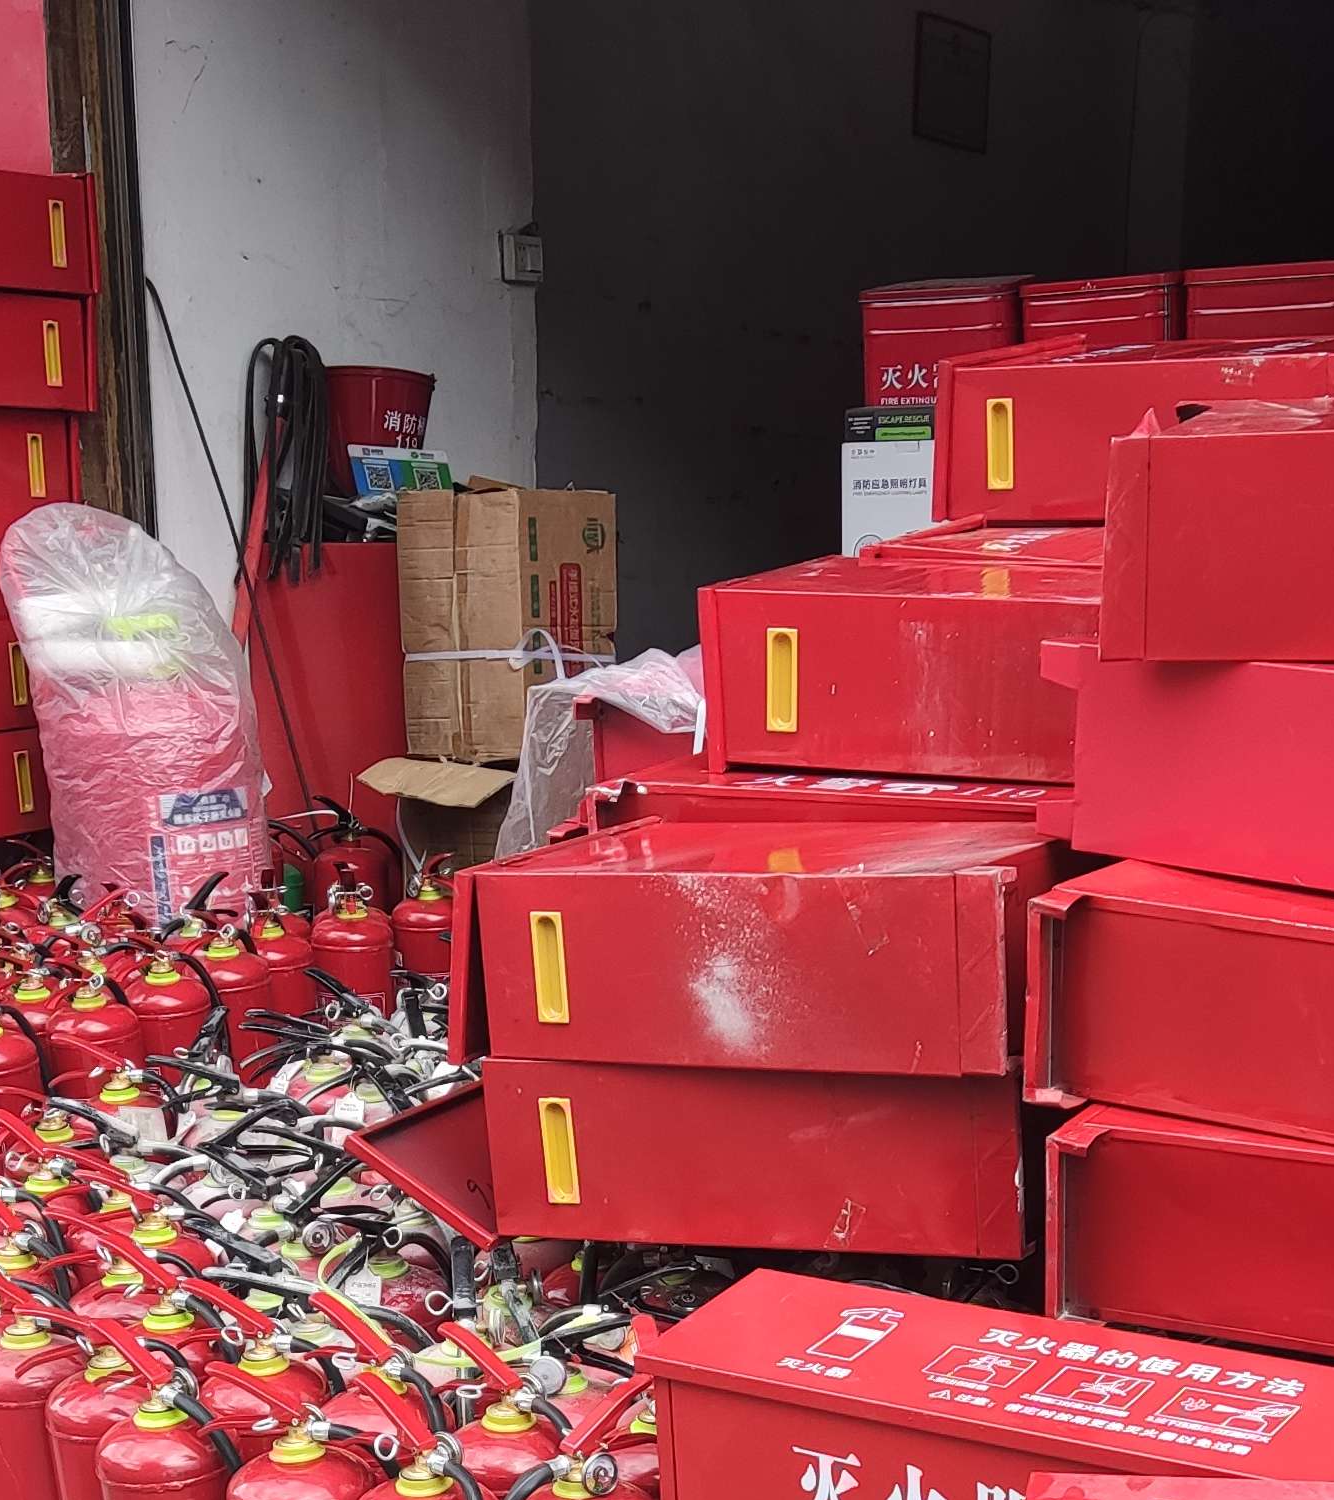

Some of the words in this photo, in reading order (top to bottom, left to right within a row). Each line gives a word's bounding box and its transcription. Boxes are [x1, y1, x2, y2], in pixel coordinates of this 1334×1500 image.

[880, 363, 939, 391] 灭火
[880, 396, 899, 406] FIRE
[852, 477, 927, 490] 消防应急照明灯具
[956, 787, 1047, 800] 119
[776, 1357, 850, 1380] 灭火器
[979, 1328, 1306, 1399] 灭火器的使用方法
